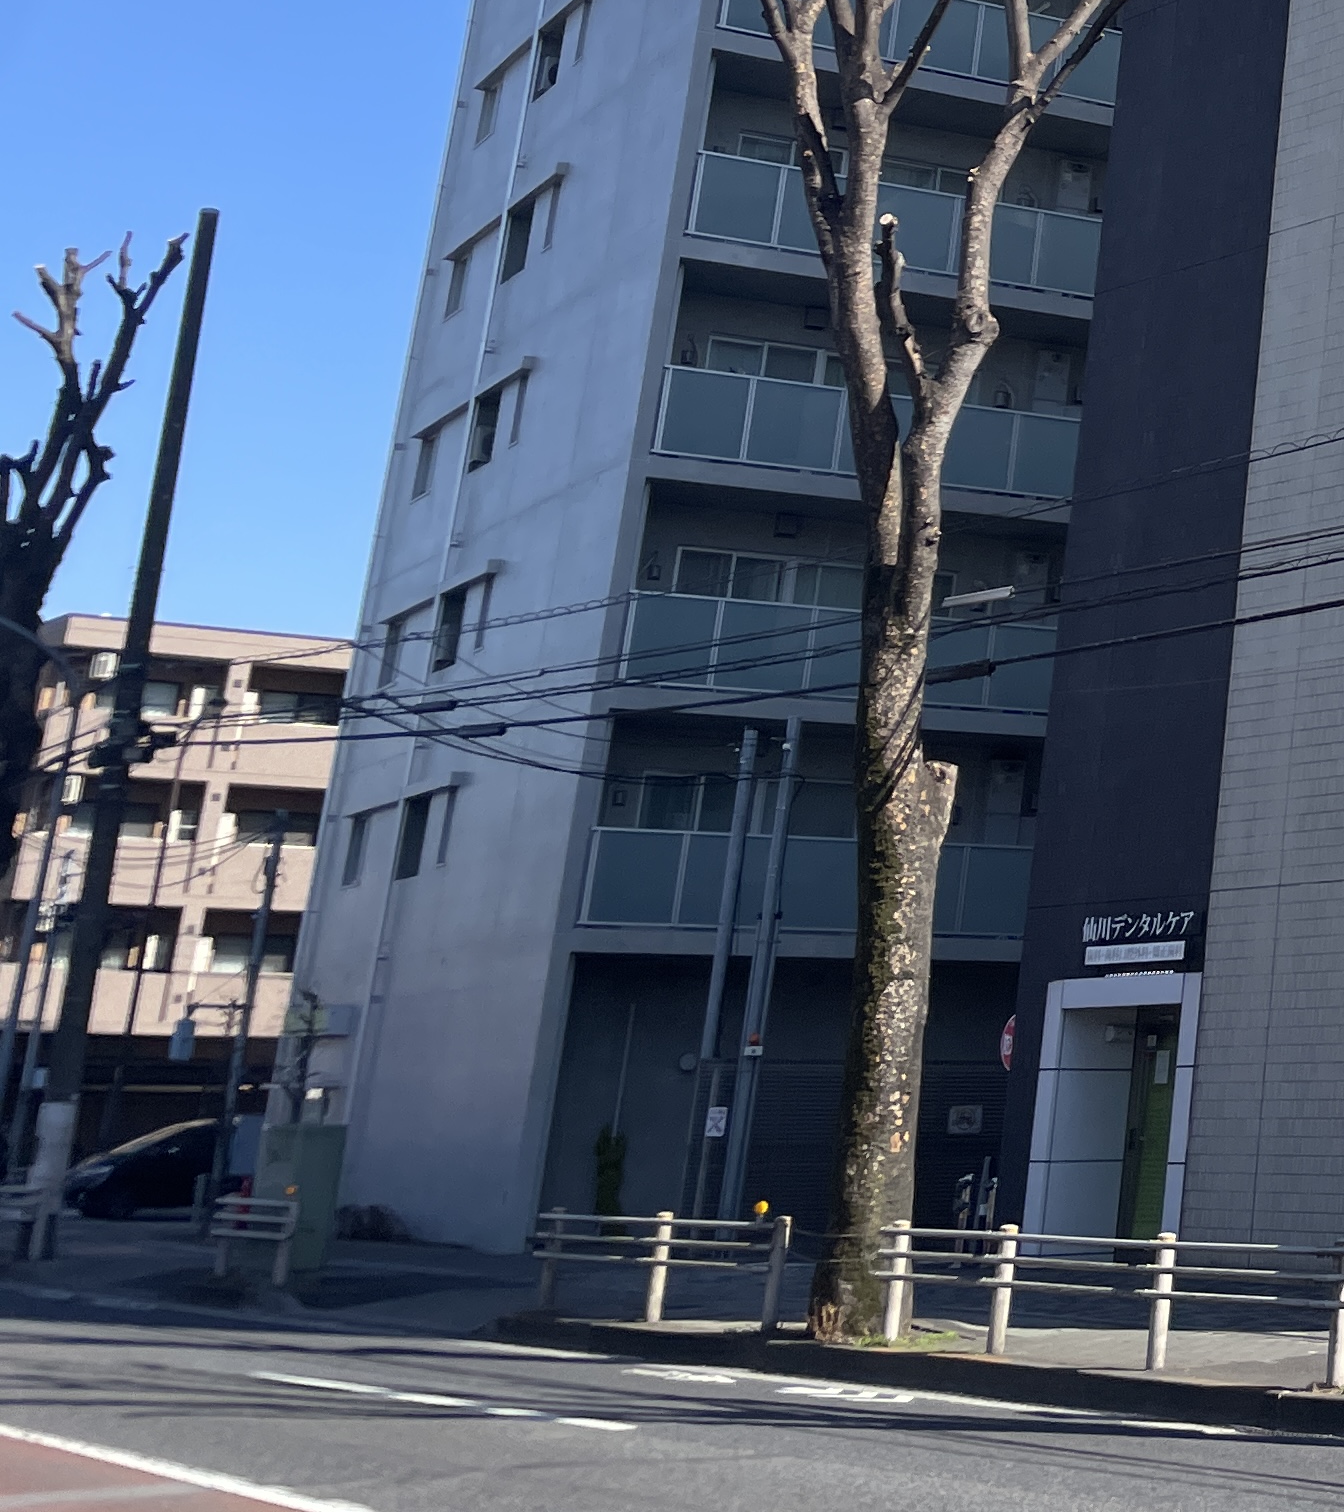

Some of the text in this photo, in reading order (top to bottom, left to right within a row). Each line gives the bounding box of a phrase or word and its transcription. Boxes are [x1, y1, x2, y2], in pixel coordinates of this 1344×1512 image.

[1082, 910, 1195, 943] 仙川デンタルケア
